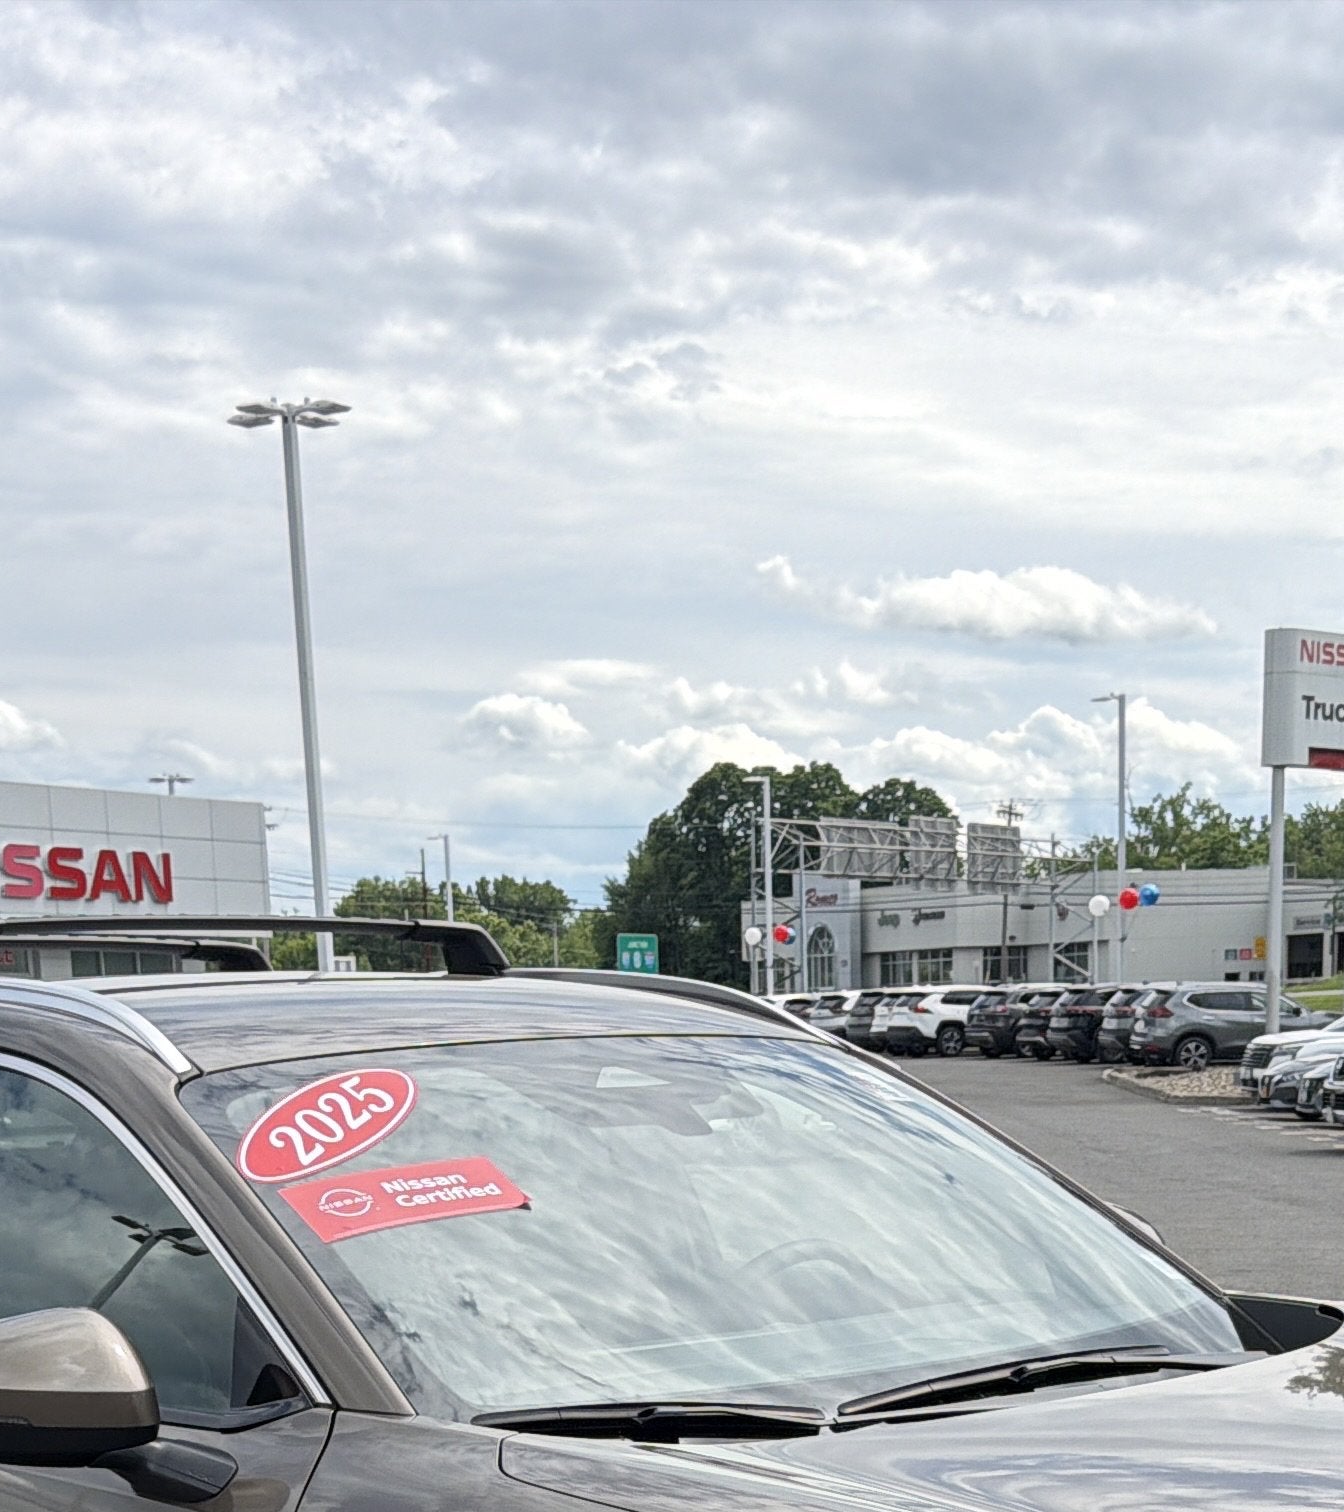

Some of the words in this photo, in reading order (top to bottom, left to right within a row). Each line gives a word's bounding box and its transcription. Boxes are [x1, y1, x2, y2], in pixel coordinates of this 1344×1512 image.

[268, 1075, 395, 1166] 2025
[380, 1172, 468, 1195] Nissan
[395, 1182, 503, 1208] Certified
